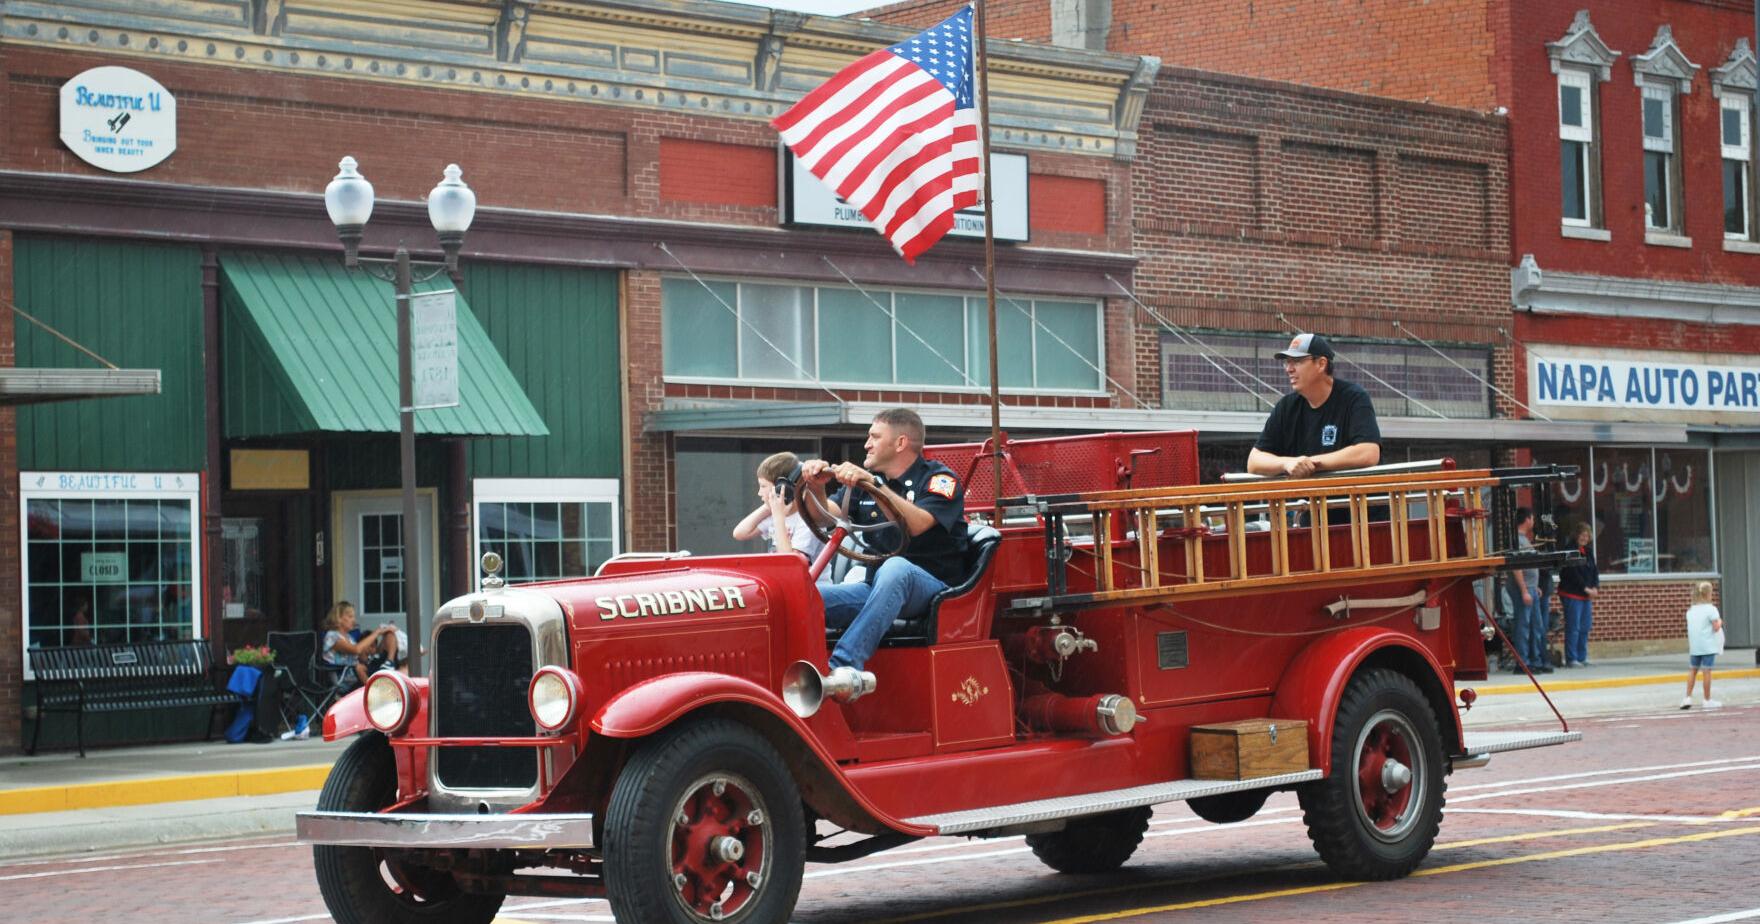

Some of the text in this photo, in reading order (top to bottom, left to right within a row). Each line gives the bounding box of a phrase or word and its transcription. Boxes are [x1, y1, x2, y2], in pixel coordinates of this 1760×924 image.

[148, 92, 161, 111] U
[119, 147, 144, 155] BEAUTY
[1538, 362, 1760, 408] NAPA AUTO PAR
[89, 565, 119, 576] CLOSED
[595, 586, 747, 621] SCRIBNER
